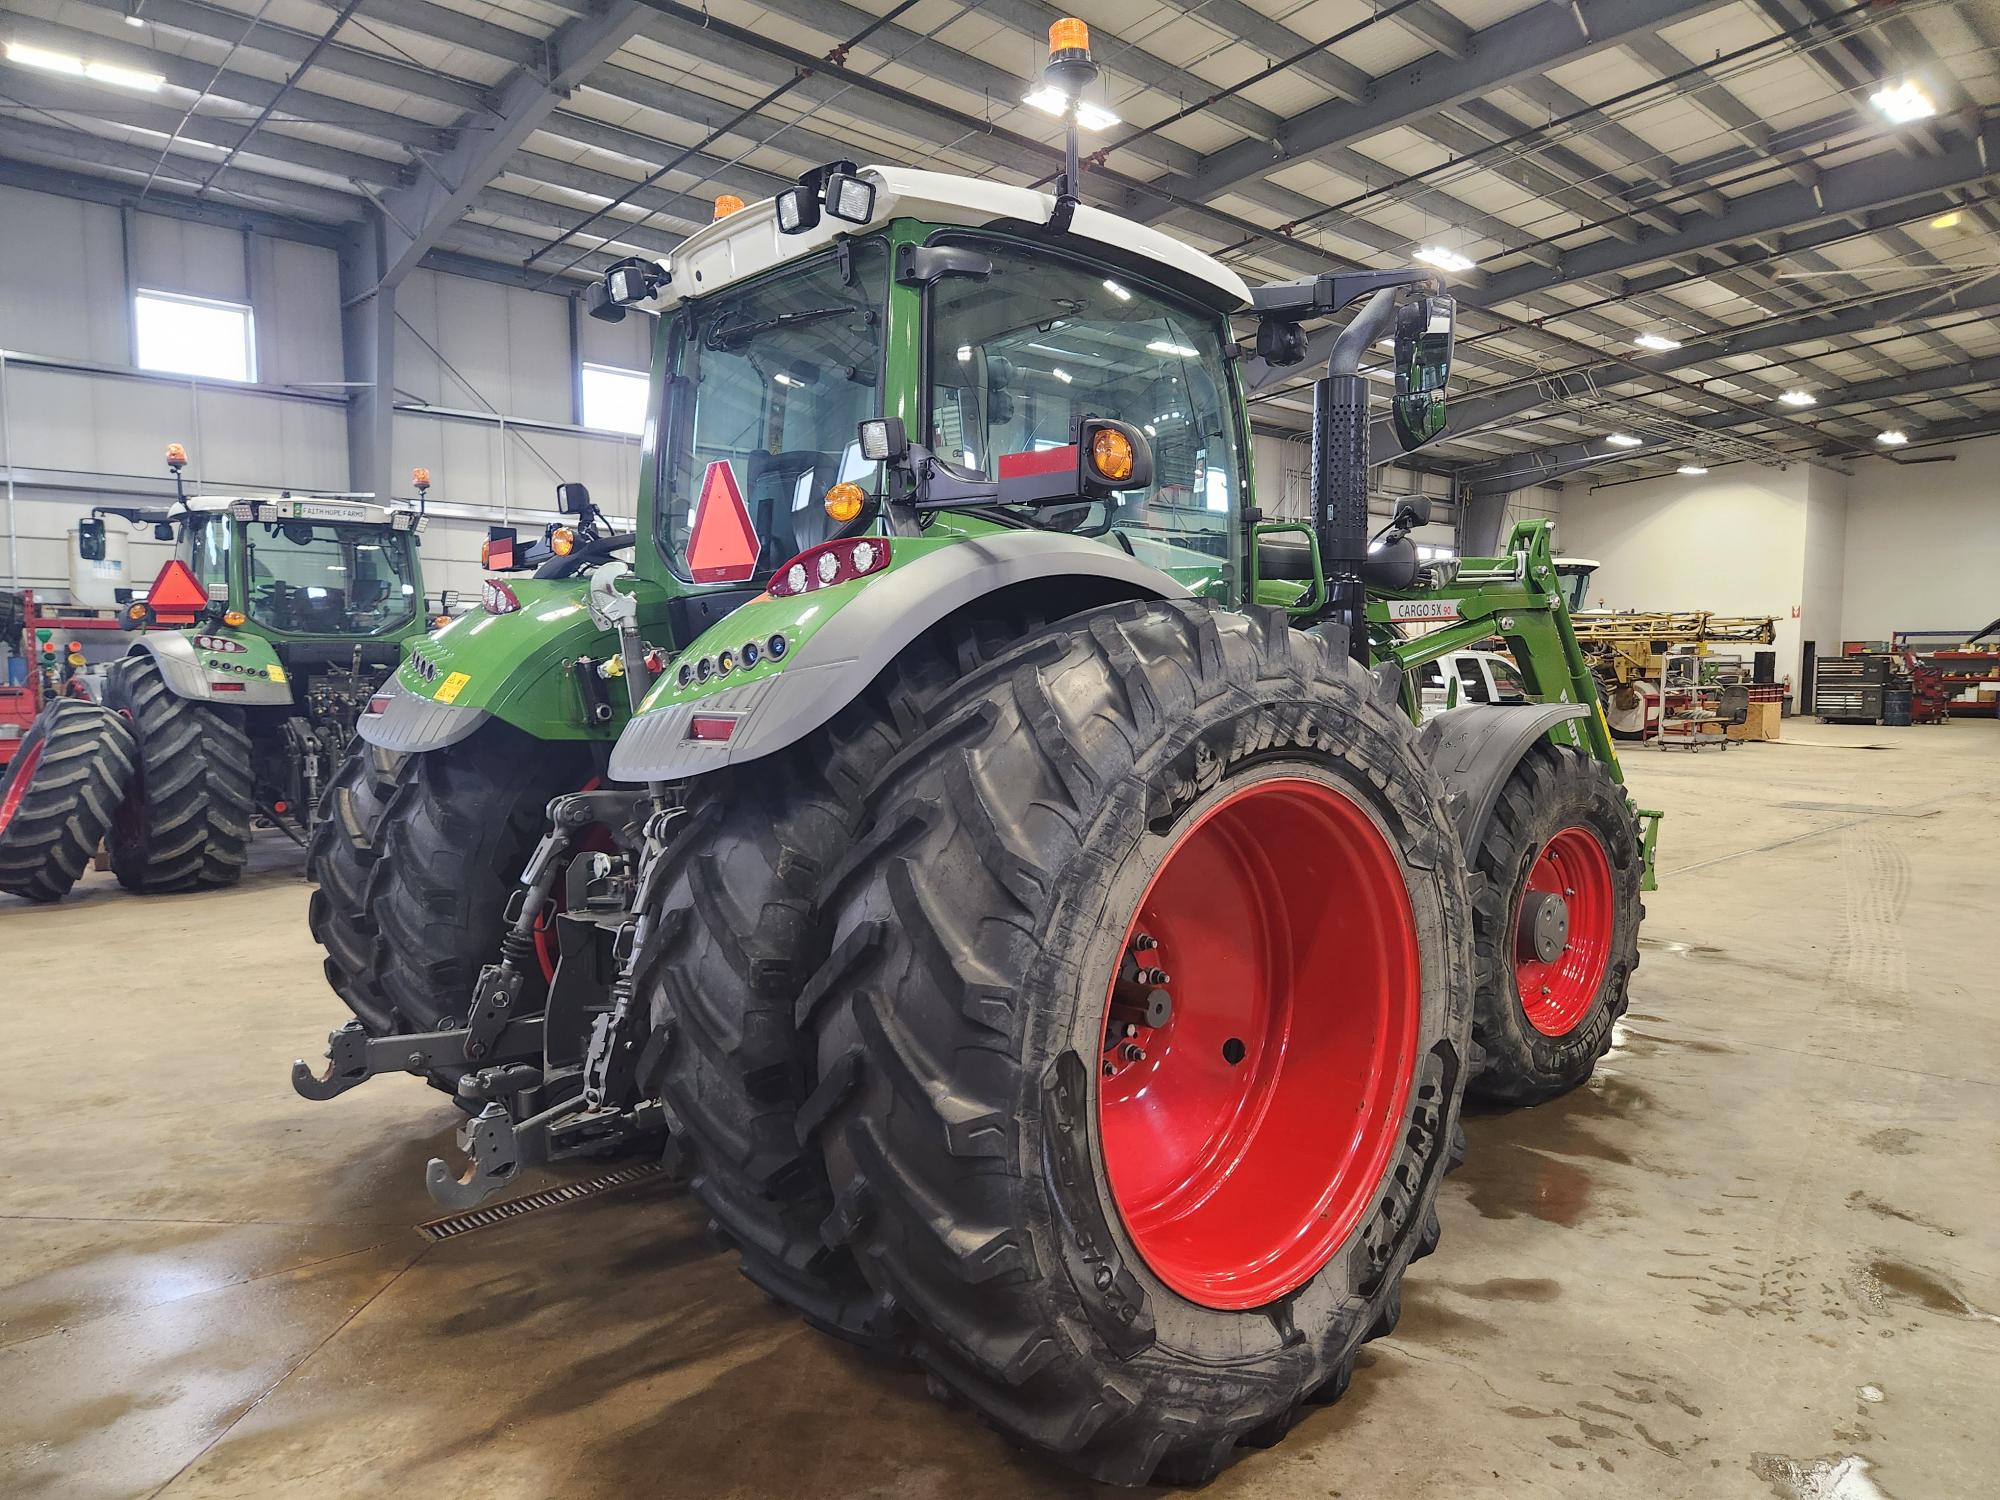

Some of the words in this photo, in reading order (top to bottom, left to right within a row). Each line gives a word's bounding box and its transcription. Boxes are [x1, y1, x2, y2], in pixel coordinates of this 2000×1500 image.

[303, 507, 323, 515] FAITH
[324, 508, 342, 516] HOPE
[1398, 604, 1429, 617] CARGO
[1431, 603, 1442, 616] 5X
[1443, 606, 1451, 615] 90
